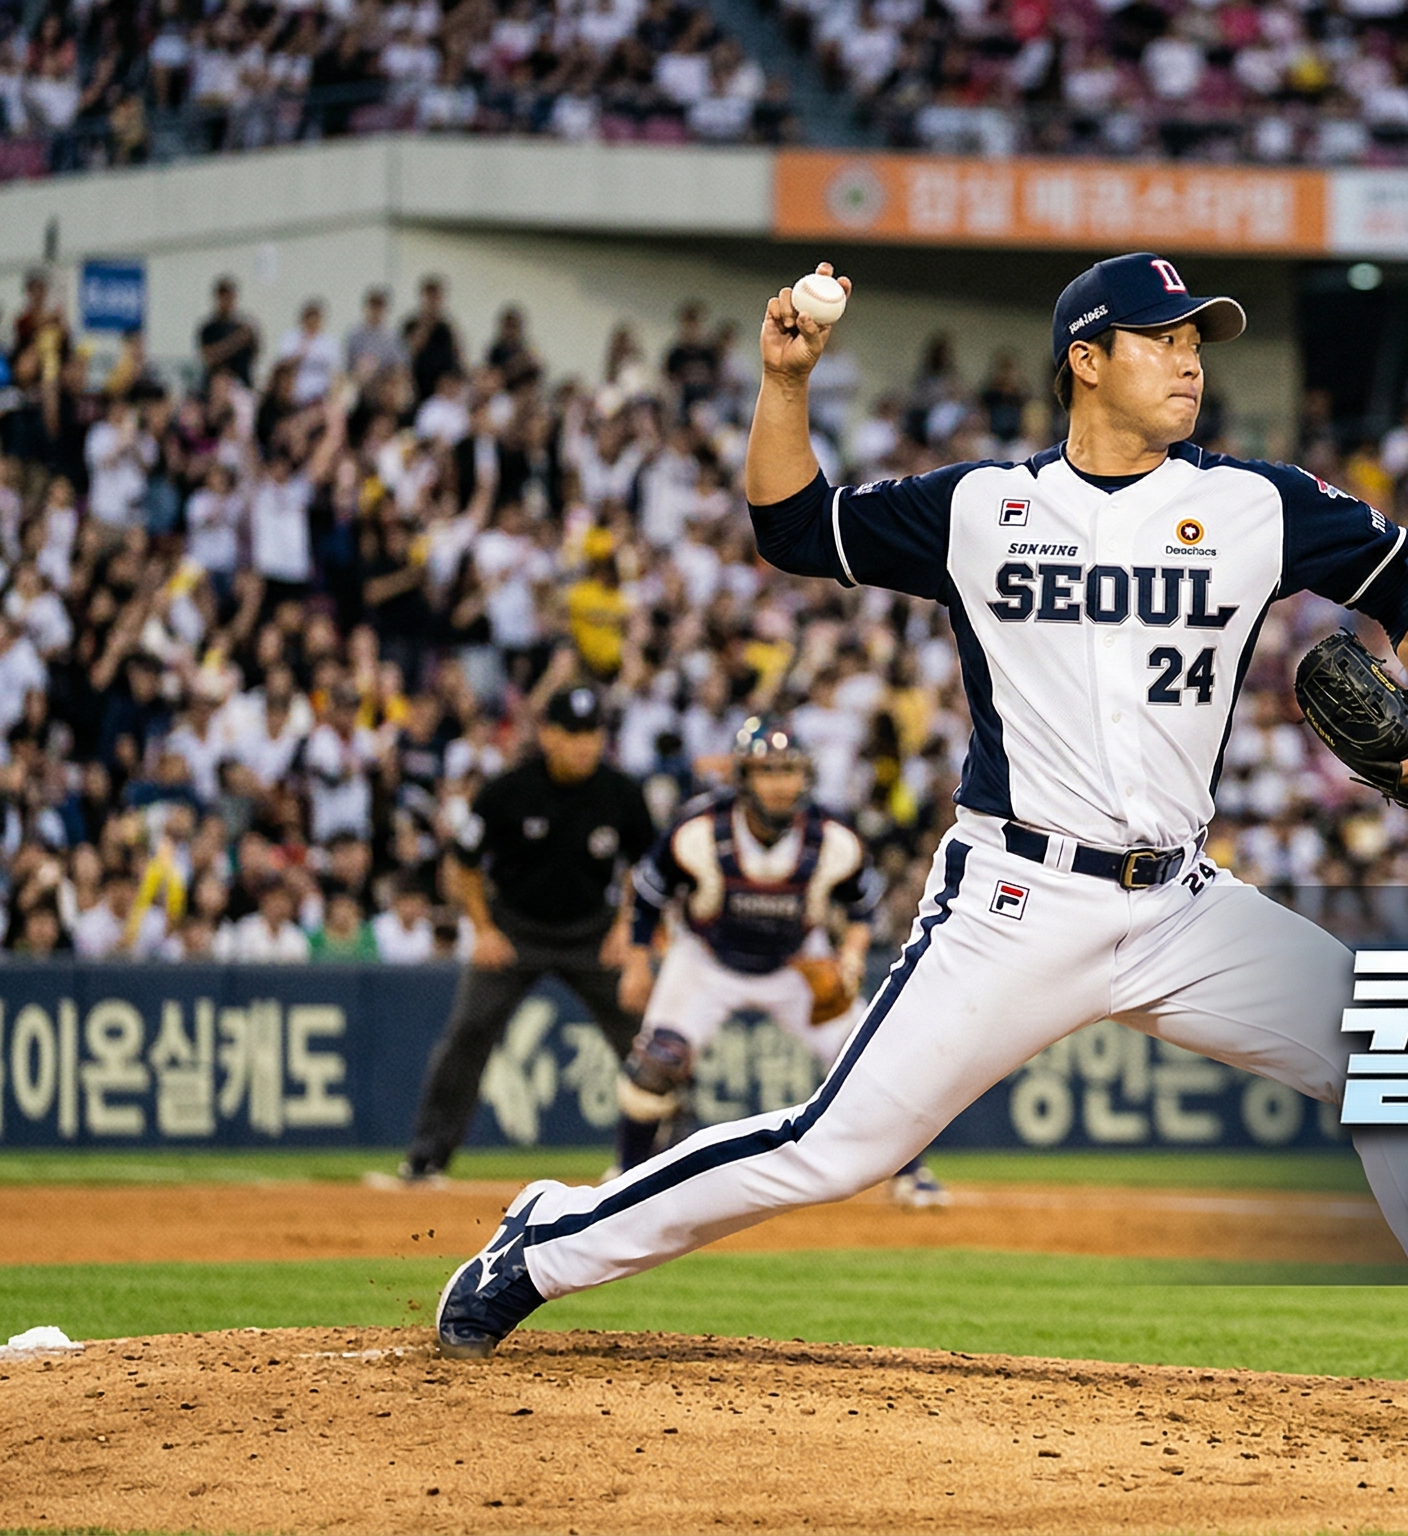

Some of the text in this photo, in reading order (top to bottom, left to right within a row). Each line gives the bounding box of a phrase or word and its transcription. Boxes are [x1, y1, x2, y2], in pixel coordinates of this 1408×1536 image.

[1151, 259, 1187, 293] D
[985, 561, 1240, 630] SEOUL
[1146, 644, 1217, 706] 24
[1181, 862, 1217, 897] 24
